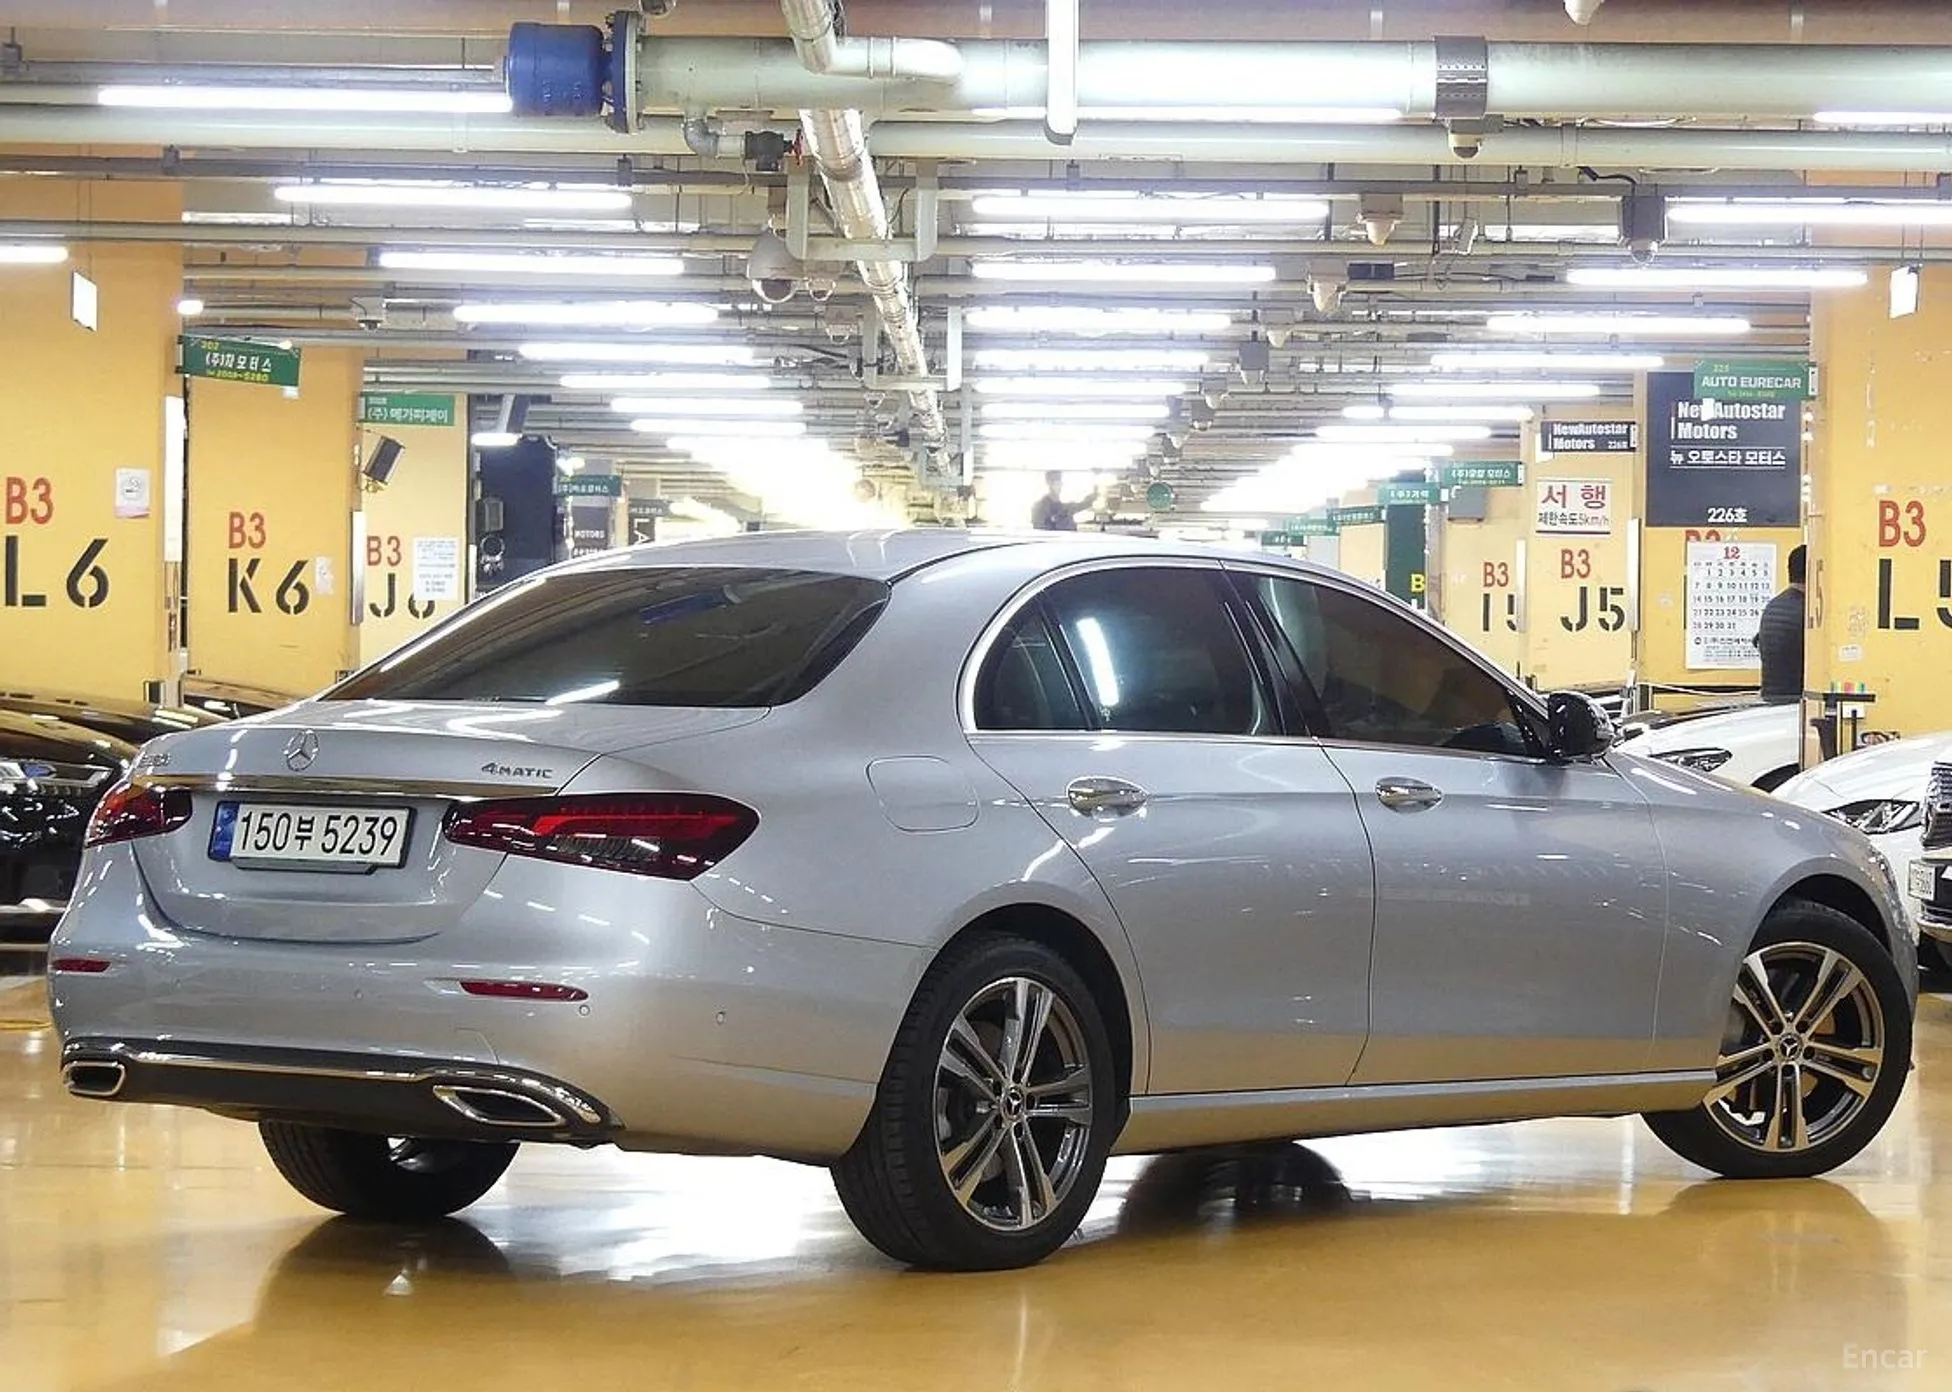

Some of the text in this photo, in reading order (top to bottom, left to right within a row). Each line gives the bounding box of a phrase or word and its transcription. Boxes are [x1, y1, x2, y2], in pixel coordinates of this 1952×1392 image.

[1701, 376, 1802, 389] AUTO EURECAR
[1677, 401, 1786, 420] NeAutostar
[1552, 423, 1629, 436] NewAutostar
[1677, 422, 1738, 440] Motors
[1552, 437, 1596, 450] Motors
[1670, 449, 1684, 465] 뉴
[1744, 450, 1786, 466] 모터스
[5, 476, 54, 525] B3
[1707, 506, 1748, 523] 226호
[1878, 500, 1927, 547] B3
[228, 511, 266, 549] B3
[366, 535, 402, 567] B3
[1560, 548, 1591, 579] B3
[1723, 546, 1741, 559] 12
[5, 535, 109, 608] L6
[1482, 561, 1509, 588] B3
[228, 557, 309, 616] K6
[1560, 586, 1625, 631] J5
[481, 762, 553, 779] 4MATIC
[240, 810, 398, 857] 150부 5239
